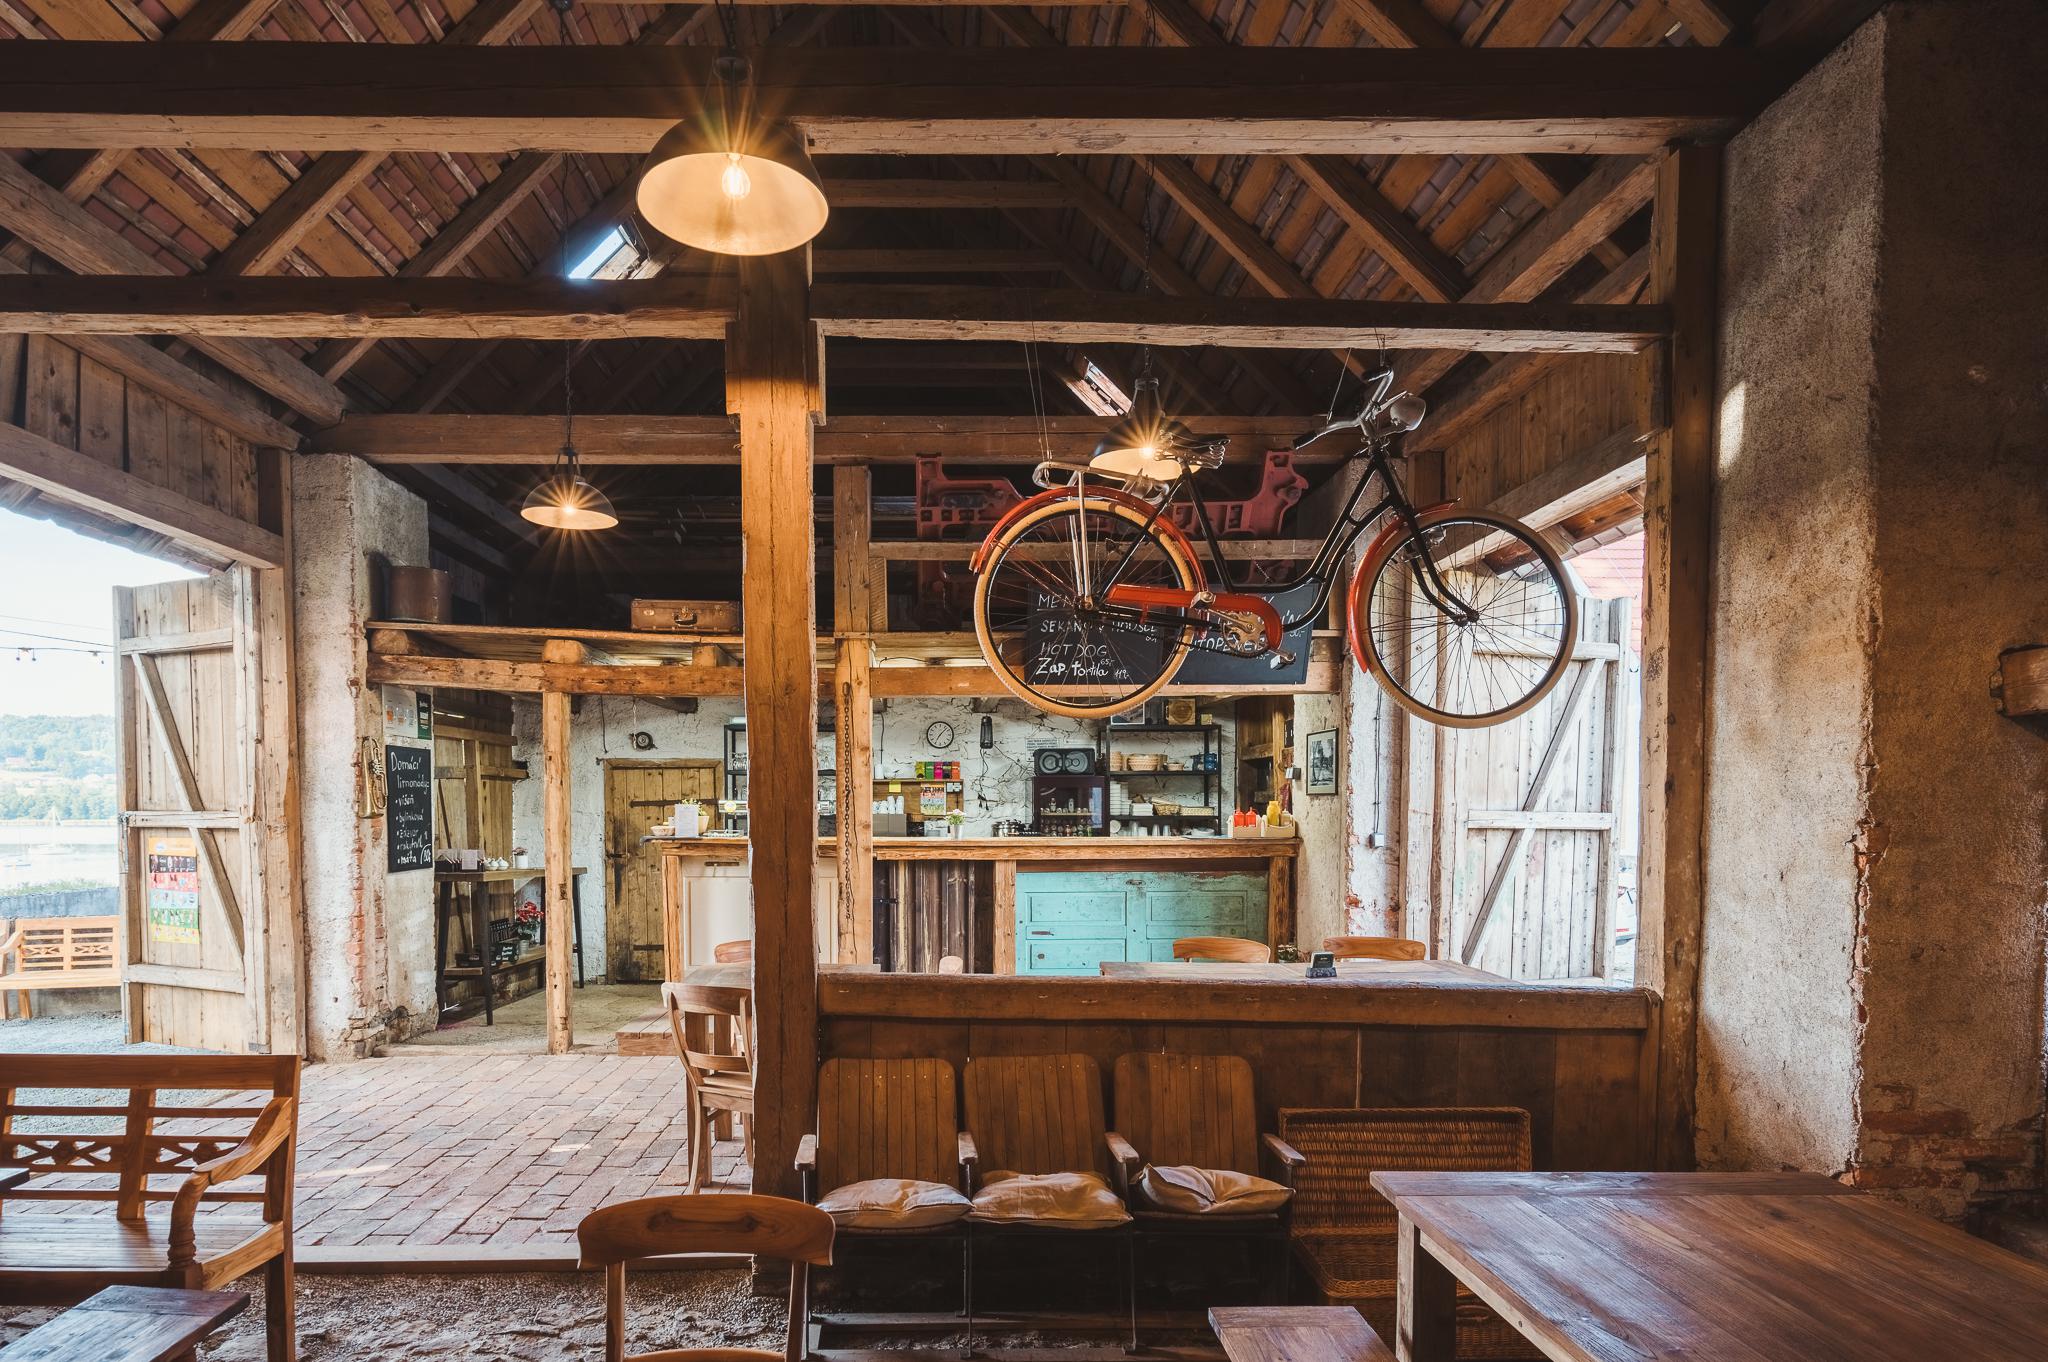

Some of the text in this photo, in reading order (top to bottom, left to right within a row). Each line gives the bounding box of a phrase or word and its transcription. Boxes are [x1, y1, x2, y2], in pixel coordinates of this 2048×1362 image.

[1040, 641, 1073, 656] HOT
[1076, 643, 1107, 658] DOG
[1035, 657, 1068, 676] Zap.
[390, 751, 422, 772] Domácí
